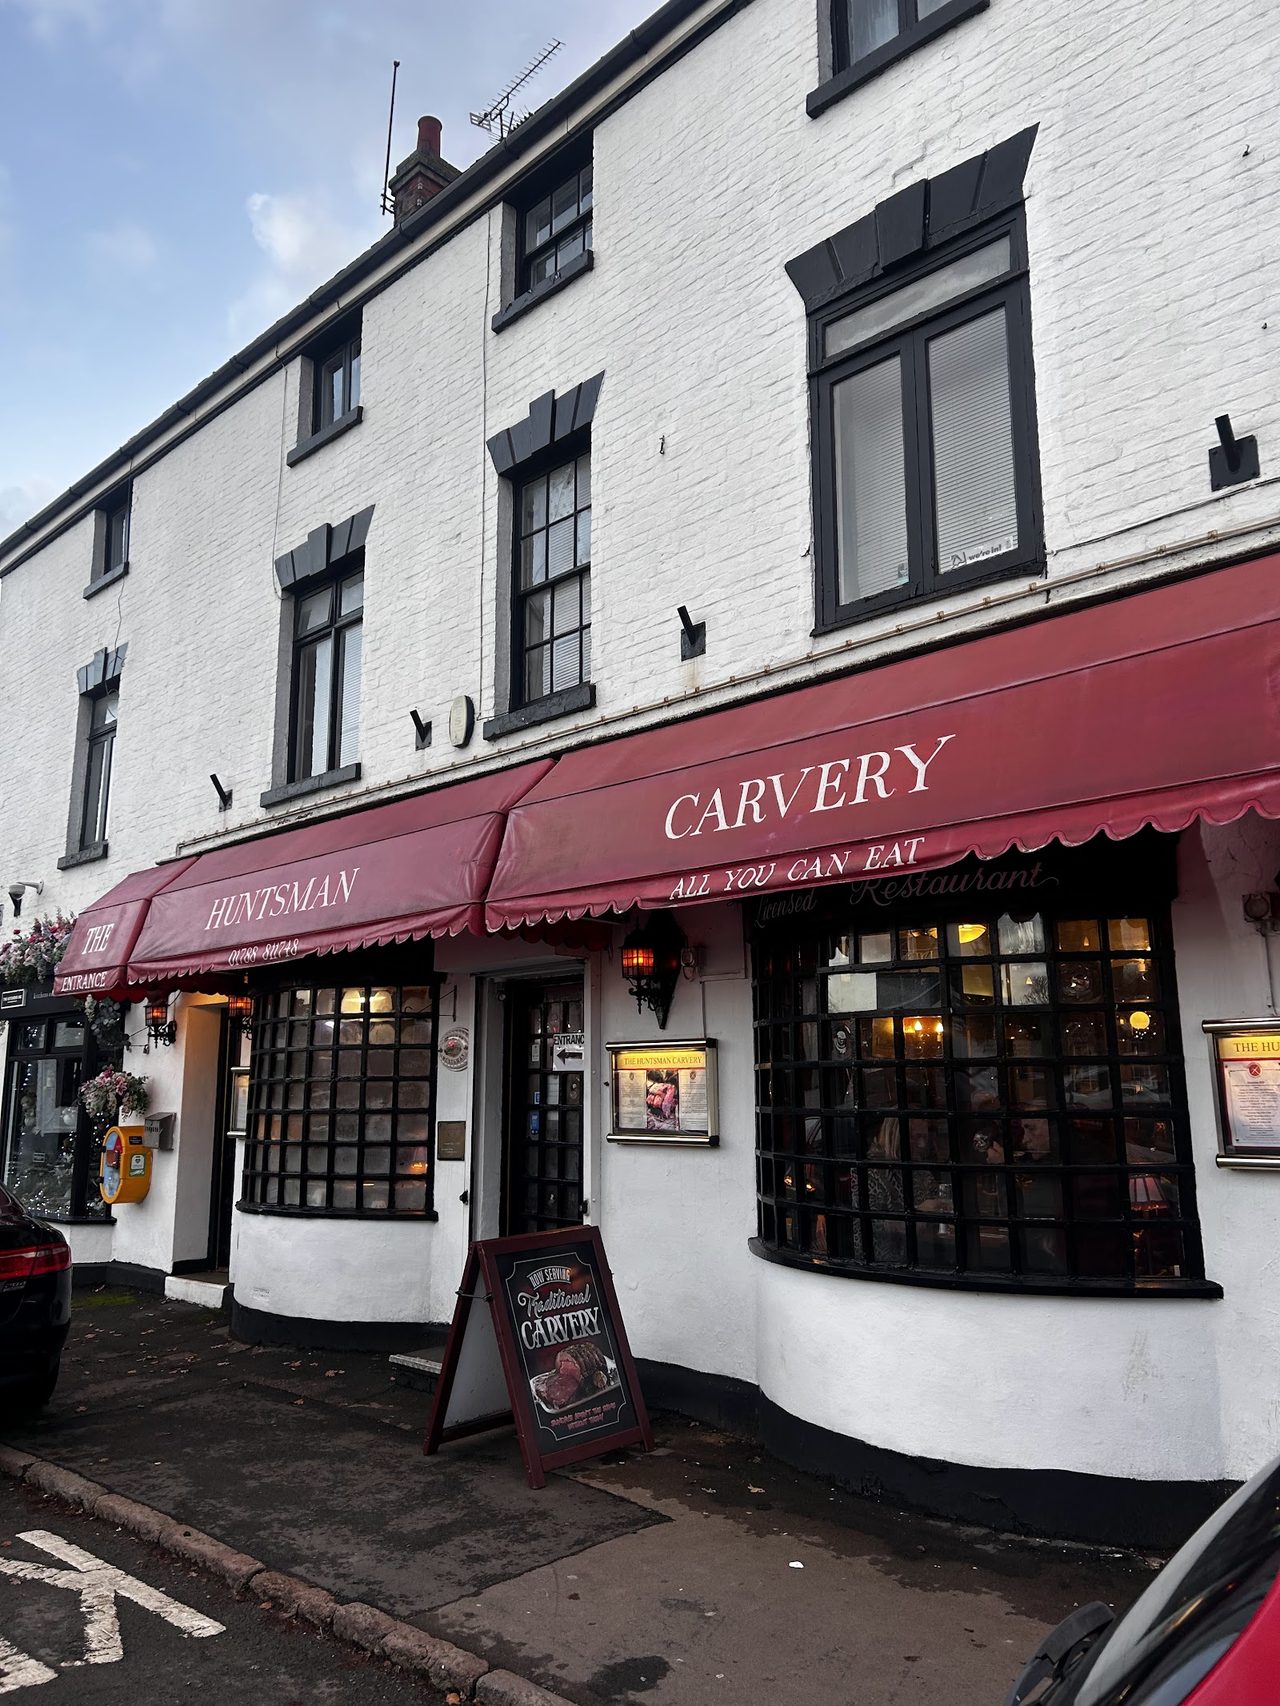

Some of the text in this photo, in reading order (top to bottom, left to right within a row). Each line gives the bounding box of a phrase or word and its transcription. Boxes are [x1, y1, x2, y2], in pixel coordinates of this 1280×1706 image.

[969, 549, 990, 560] we're
[664, 734, 956, 839] CARVERY
[669, 837, 925, 900] ALL YOU CAN EAT
[850, 861, 1060, 907] Restaurant
[204, 867, 360, 930] HUNTSMAN
[81, 923, 115, 955] THE
[228, 938, 299, 967] 01788 811748
[61, 971, 108, 992] ENTRANCE
[624, 1056, 702, 1065] THE HUNTSMAN CARVERY
[1234, 1042, 1258, 1052] THE
[529, 1267, 571, 1288] NOW SERVING
[517, 1283, 592, 1319] Traditional
[521, 1307, 601, 1350] CARVERY
